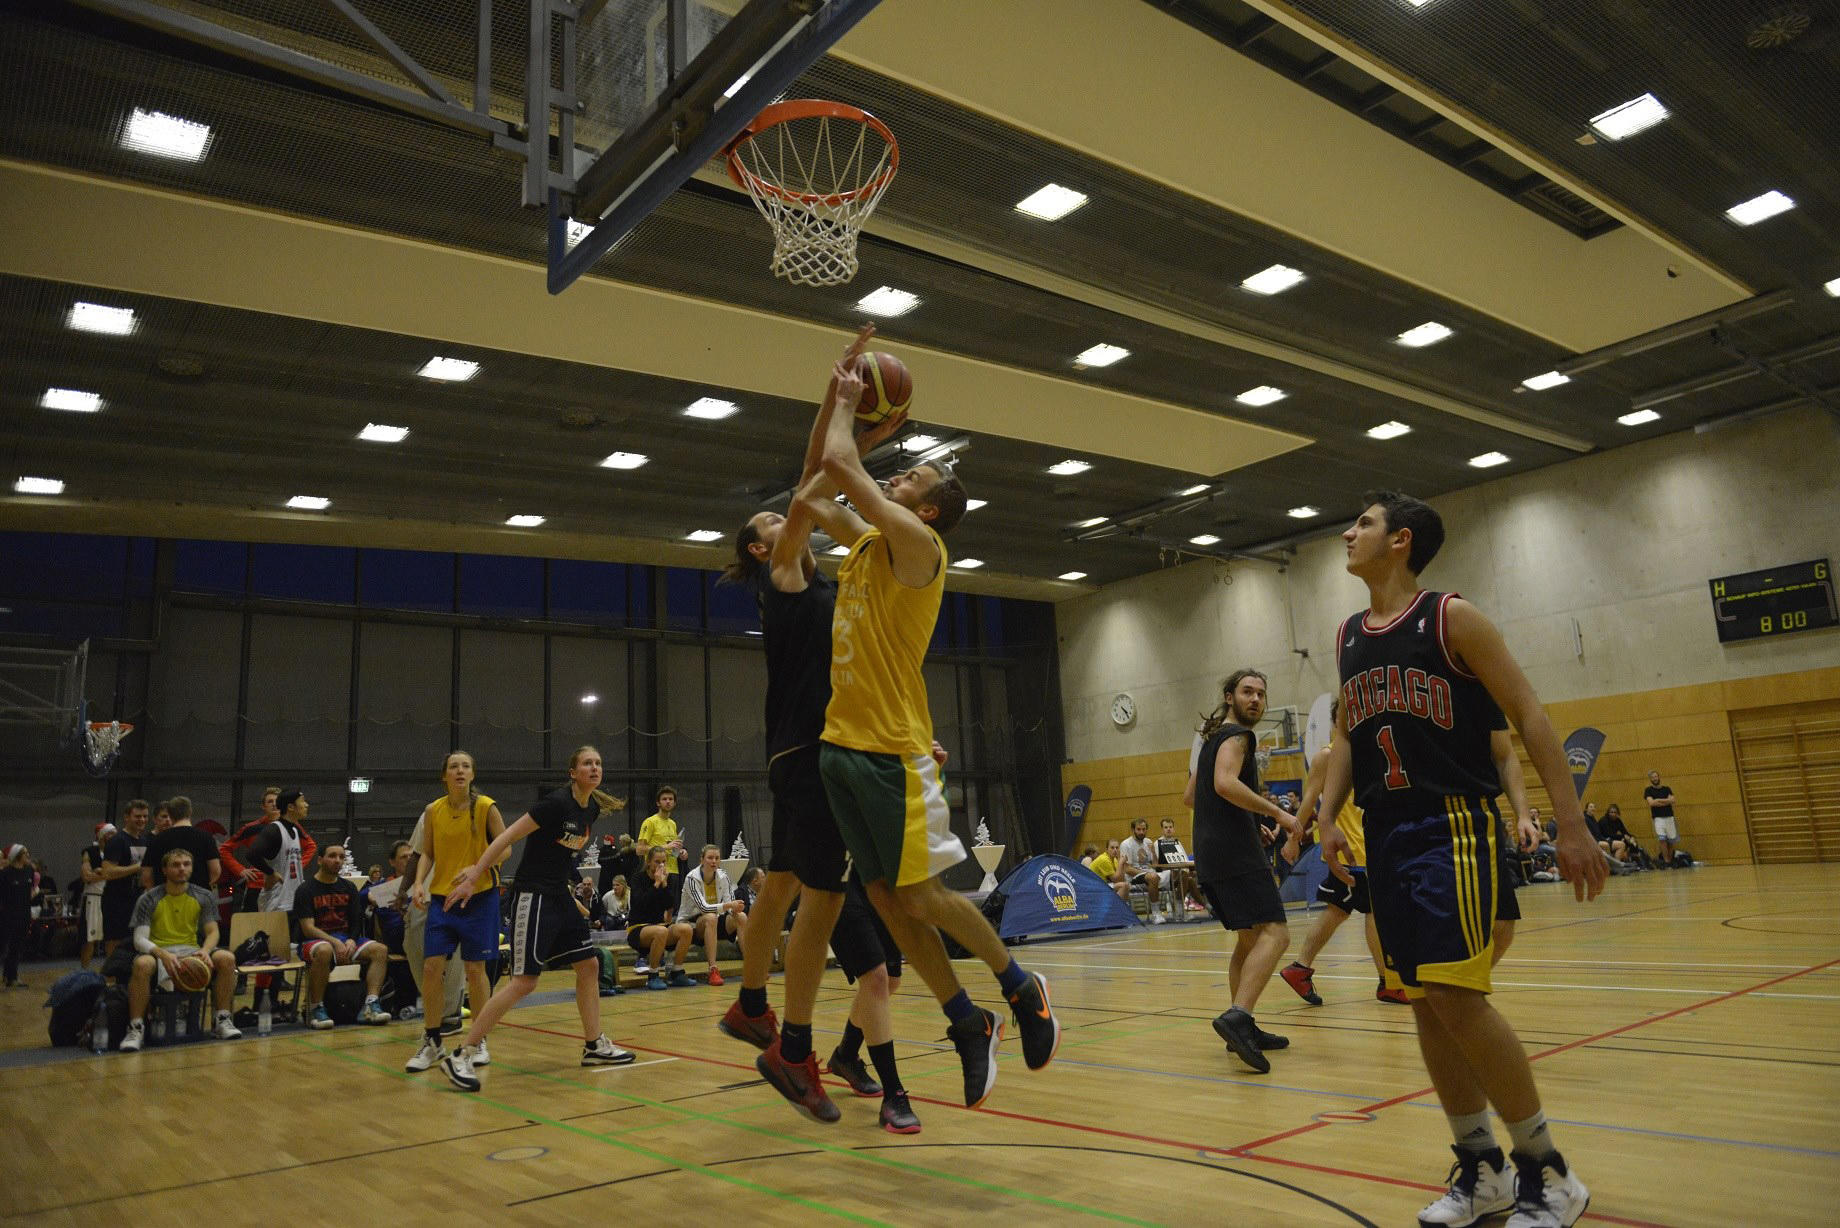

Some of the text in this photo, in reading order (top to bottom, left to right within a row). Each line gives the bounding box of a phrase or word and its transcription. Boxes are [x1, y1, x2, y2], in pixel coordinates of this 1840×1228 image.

[1714, 581, 1726, 597] H
[1815, 564, 1826, 579] G
[1760, 611, 1807, 632] 8 00
[1343, 665, 1454, 731] HICAGO
[1376, 725, 1412, 791] 1
[1053, 895, 1074, 904] ALBA
